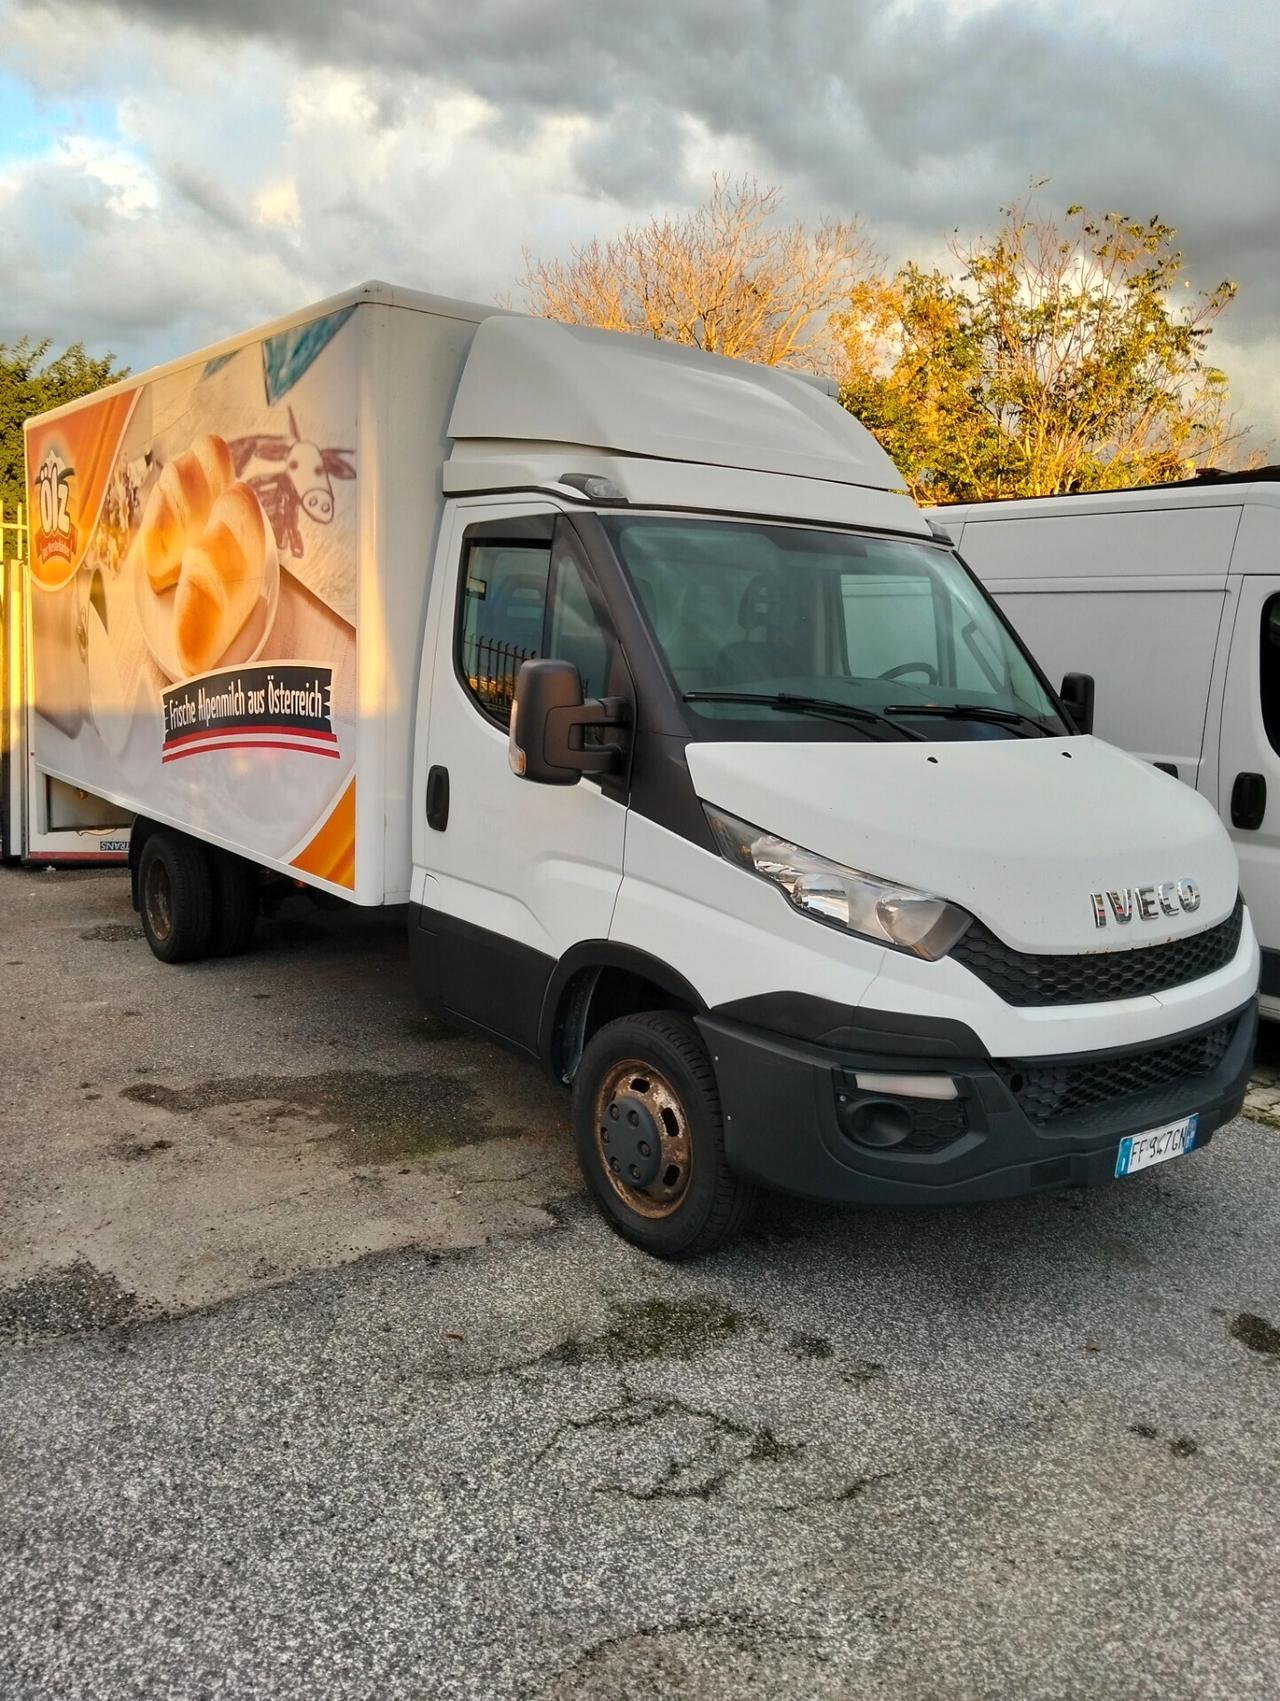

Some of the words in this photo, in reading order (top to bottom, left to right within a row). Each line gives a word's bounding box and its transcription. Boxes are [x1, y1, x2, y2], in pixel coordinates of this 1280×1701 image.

[40, 463, 70, 535] Ölz
[169, 694, 196, 730] Frische
[198, 679, 246, 727] Alpenmilch
[247, 688, 265, 715] aus
[267, 675, 322, 718] Österreich
[1090, 878, 1201, 928] IVECO
